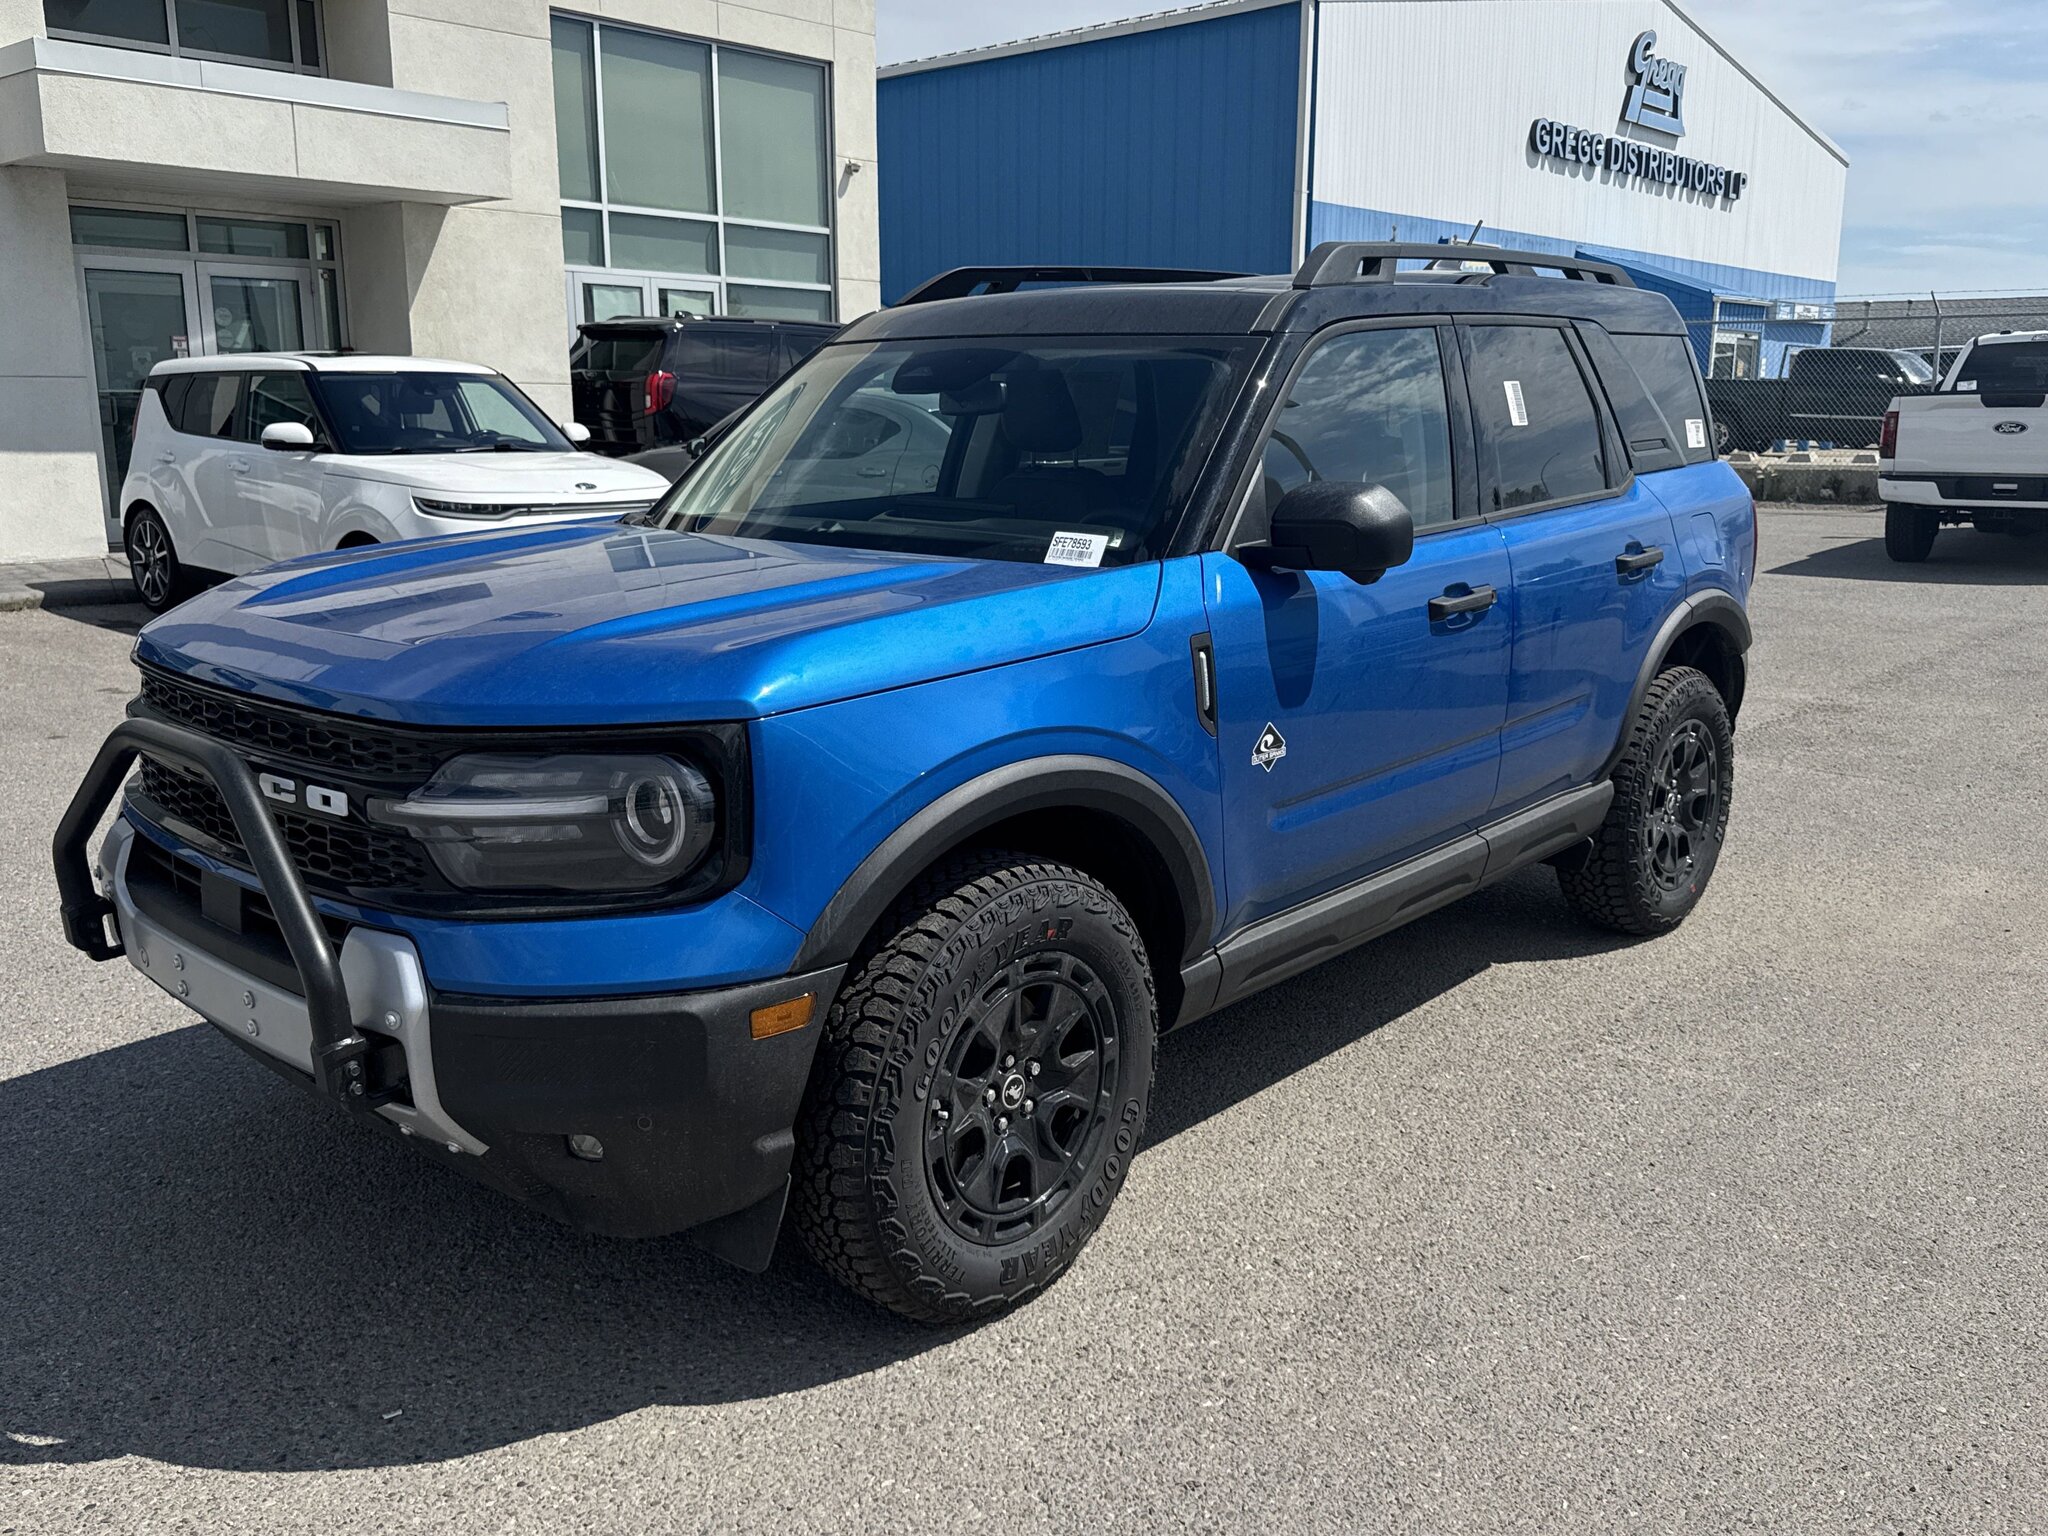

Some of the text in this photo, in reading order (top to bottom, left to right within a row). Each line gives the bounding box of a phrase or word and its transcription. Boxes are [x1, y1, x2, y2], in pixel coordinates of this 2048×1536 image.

[1629, 29, 1688, 97] Gregg
[1530, 117, 1604, 166] GREGG
[1607, 138, 1725, 196] DISTRIBUTORS
[1052, 536, 1093, 550] SFE78593
[999, 1098, 1140, 1284] GOODYEAR
[905, 1203, 966, 1285] TERRITORY
